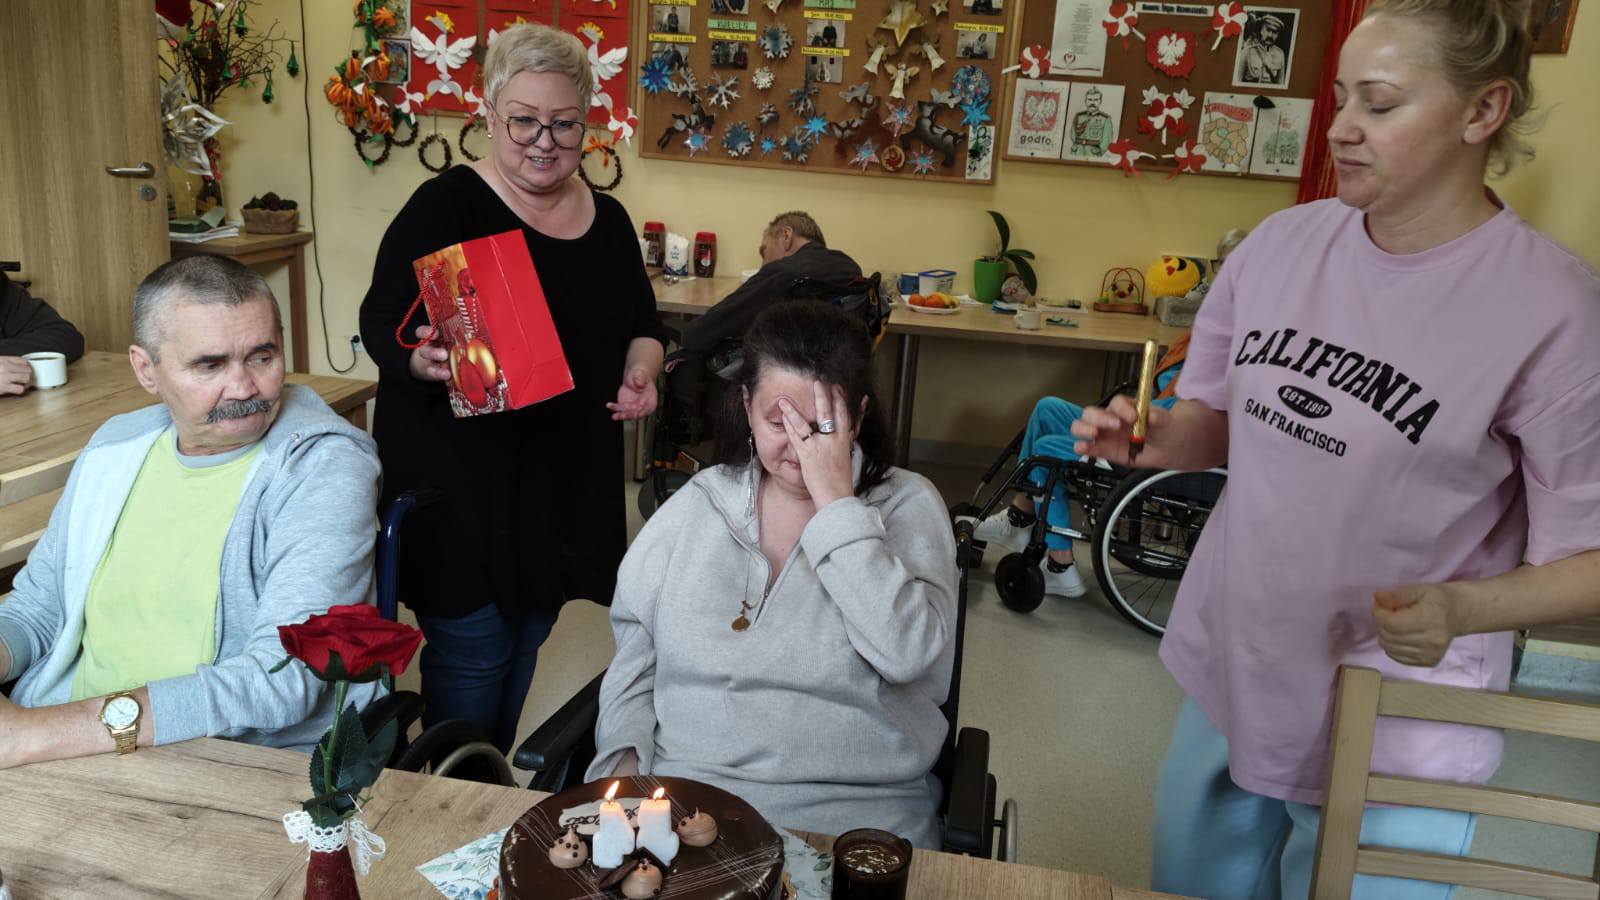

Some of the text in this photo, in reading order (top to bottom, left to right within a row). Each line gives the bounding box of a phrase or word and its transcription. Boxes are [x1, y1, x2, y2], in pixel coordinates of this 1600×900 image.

[1235, 328, 1440, 445] CALIFORNIA
[1245, 398, 1347, 457] SAN FRANCISCO
